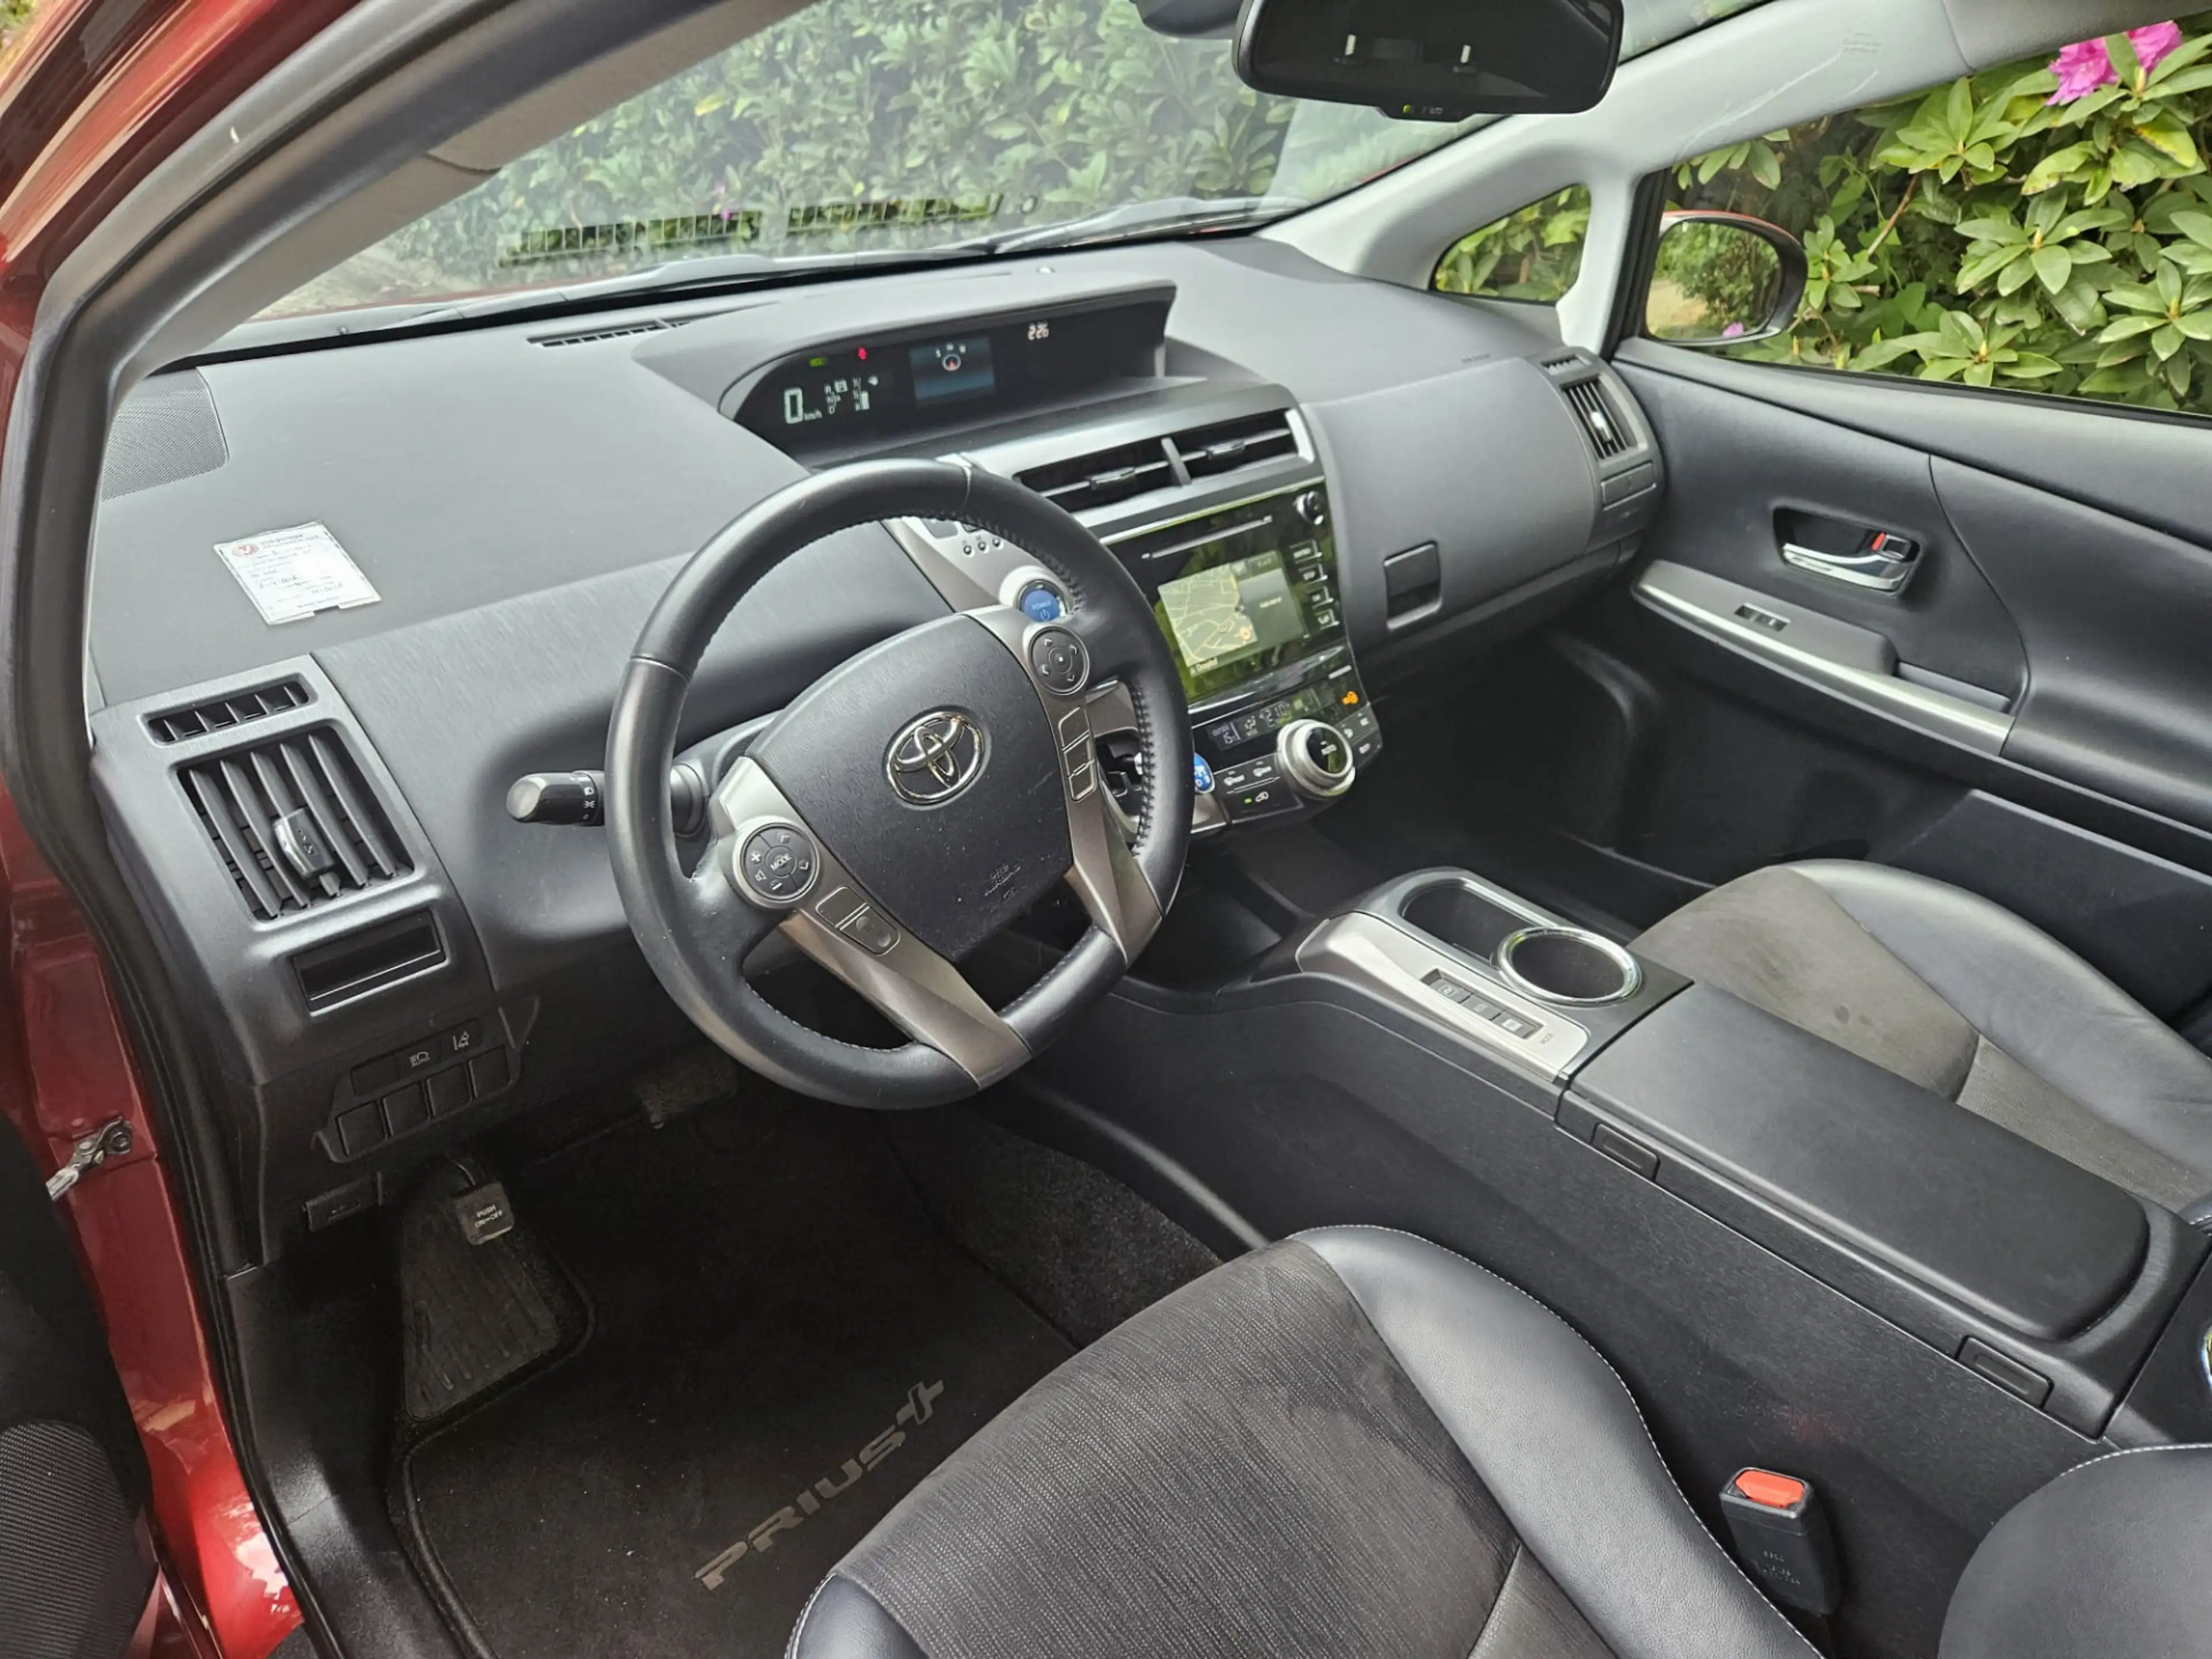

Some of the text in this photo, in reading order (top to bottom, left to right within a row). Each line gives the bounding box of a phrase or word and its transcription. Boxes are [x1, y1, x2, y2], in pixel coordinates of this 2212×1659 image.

[784, 387, 804, 424] 0
[770, 853, 792, 870] MODE
[477, 1204, 496, 1218] PUSH
